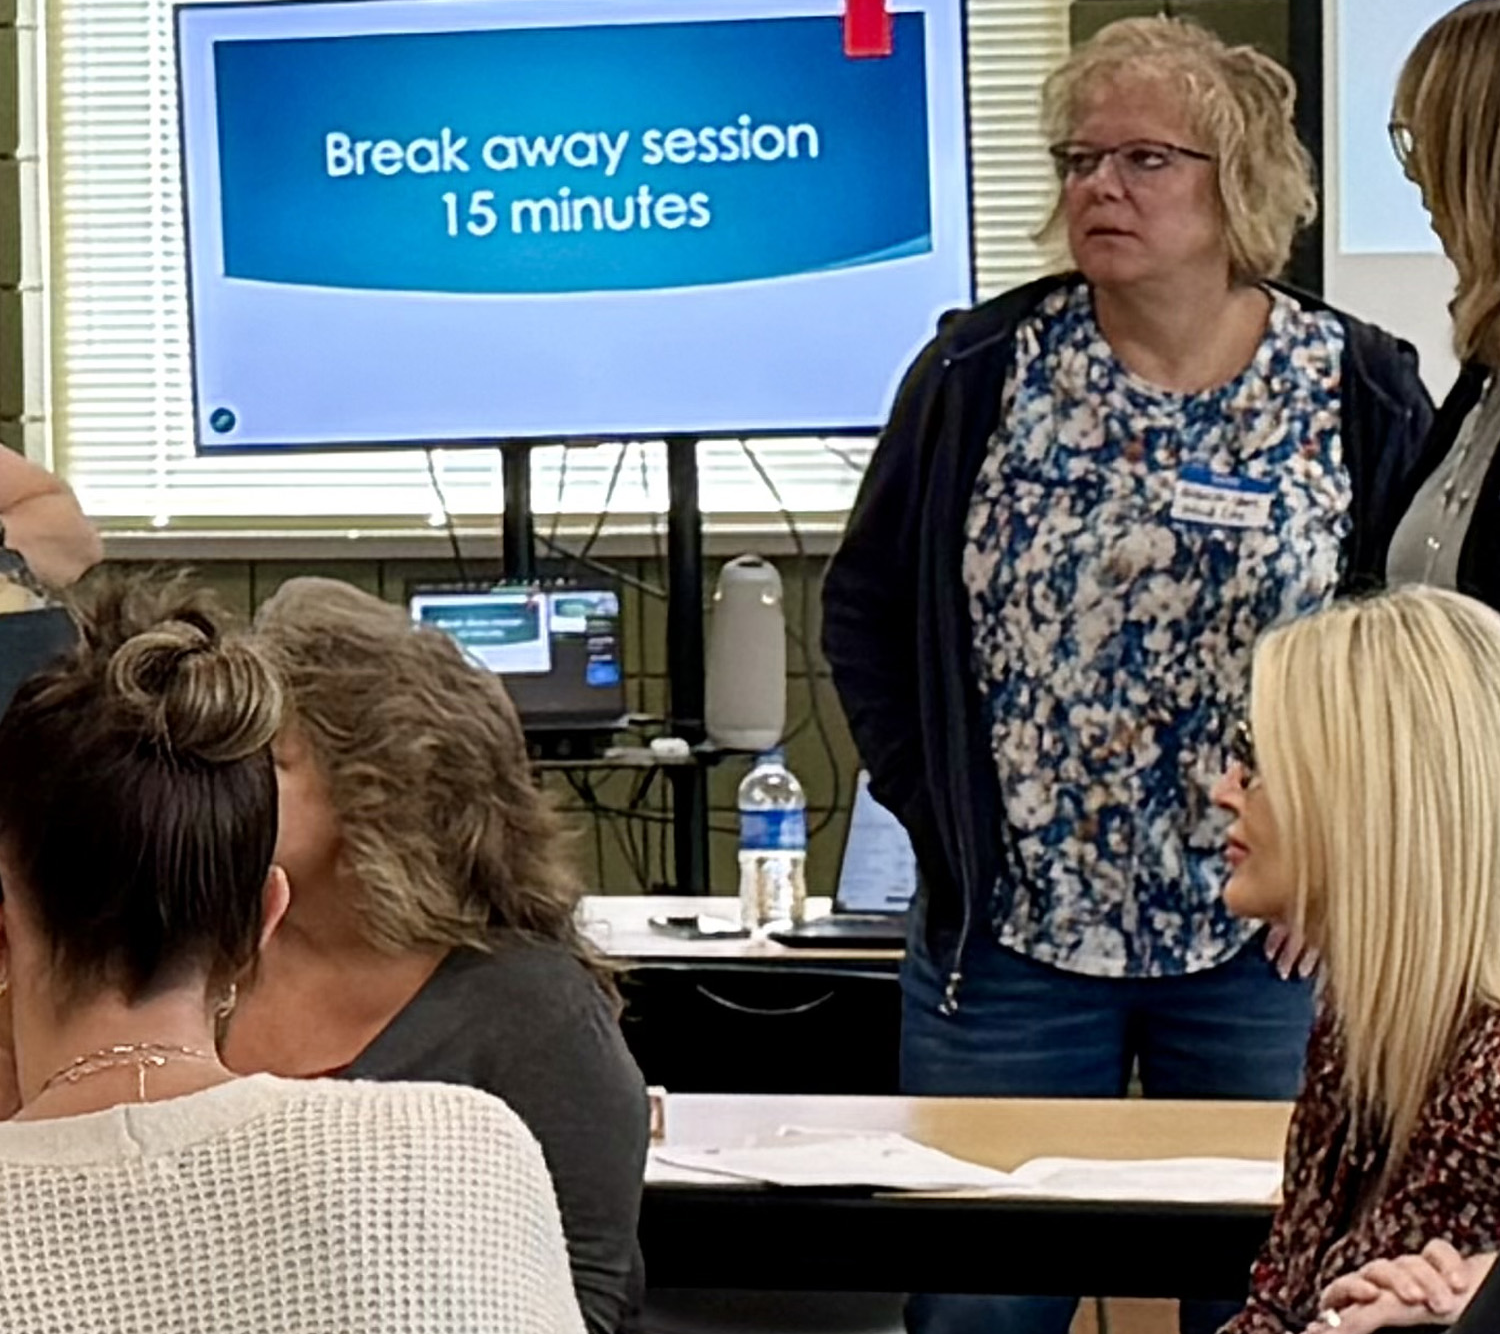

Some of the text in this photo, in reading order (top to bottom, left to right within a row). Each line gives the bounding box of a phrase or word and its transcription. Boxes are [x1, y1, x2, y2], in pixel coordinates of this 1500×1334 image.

[324, 112, 820, 179] Break away session
[440, 183, 712, 238] 15 minutes
